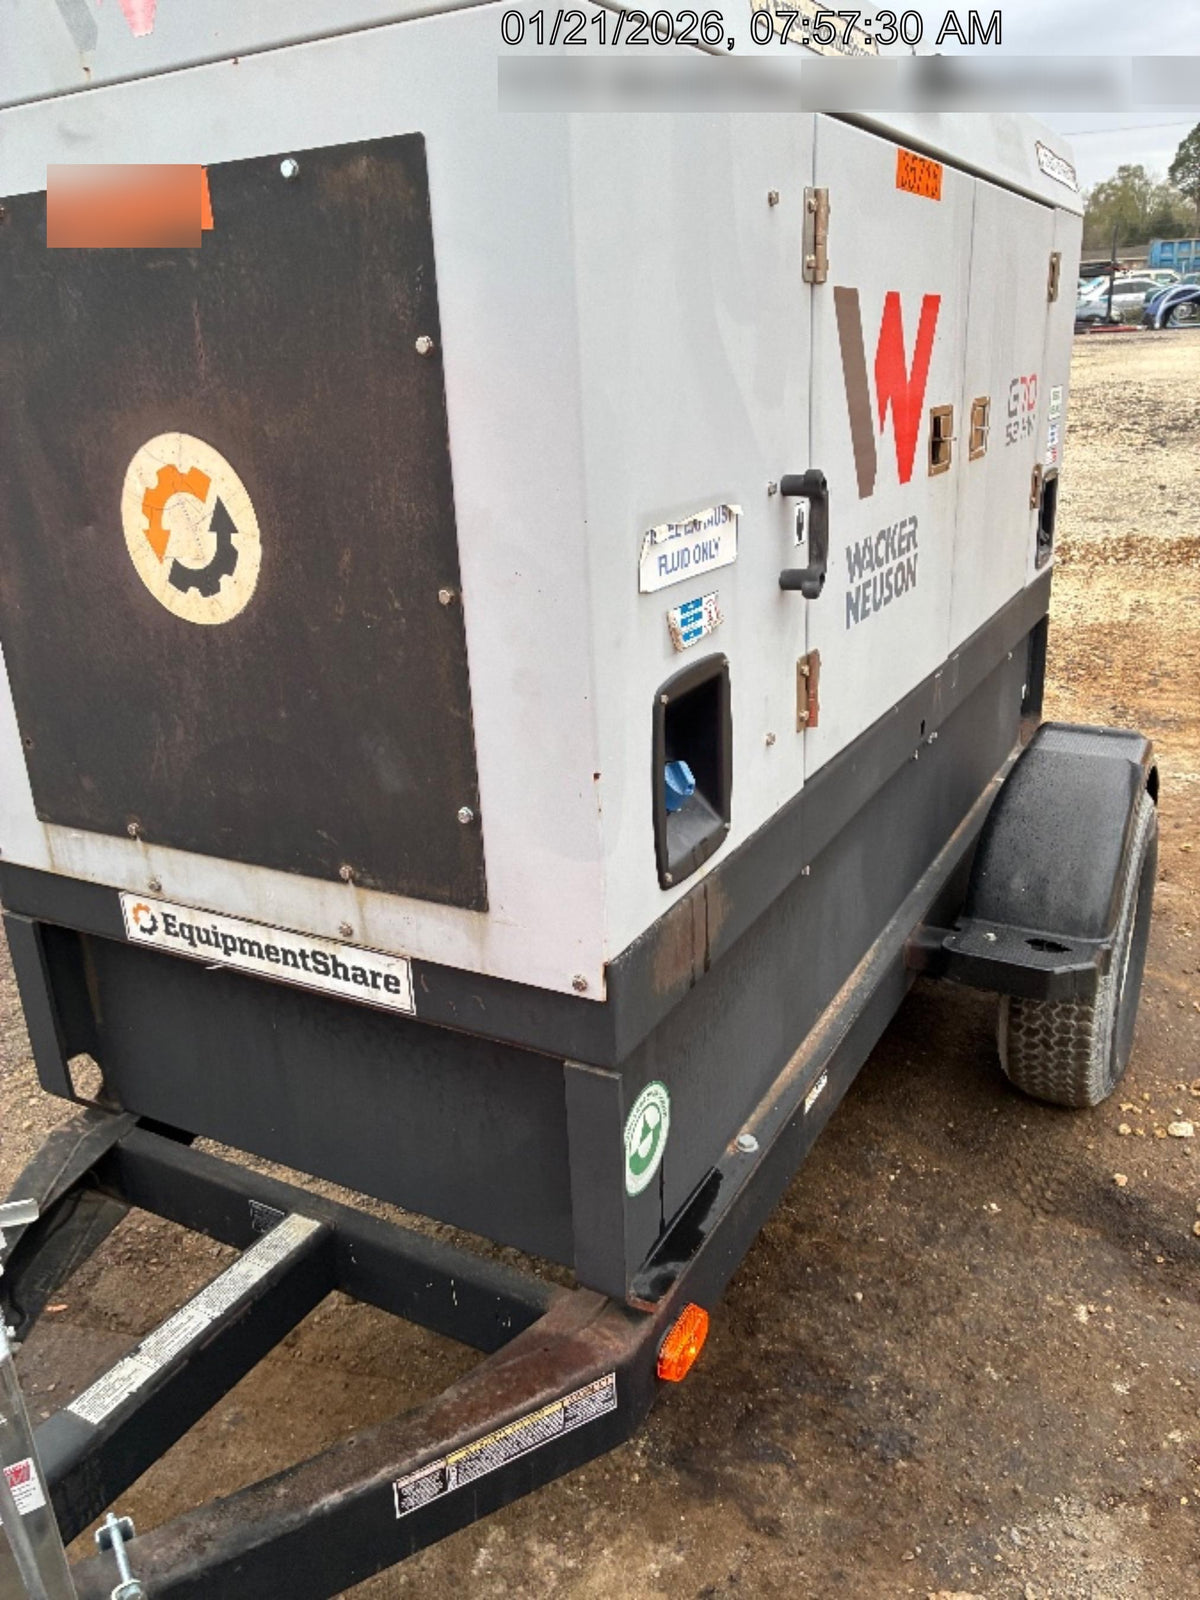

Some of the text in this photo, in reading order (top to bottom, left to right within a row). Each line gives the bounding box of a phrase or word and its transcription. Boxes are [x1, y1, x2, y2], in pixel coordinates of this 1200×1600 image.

[657, 536, 721, 577] FLUID ONLY
[845, 514, 918, 584] WACKER
[845, 552, 918, 630] NEUSON
[160, 911, 402, 995] EquipmentShare
